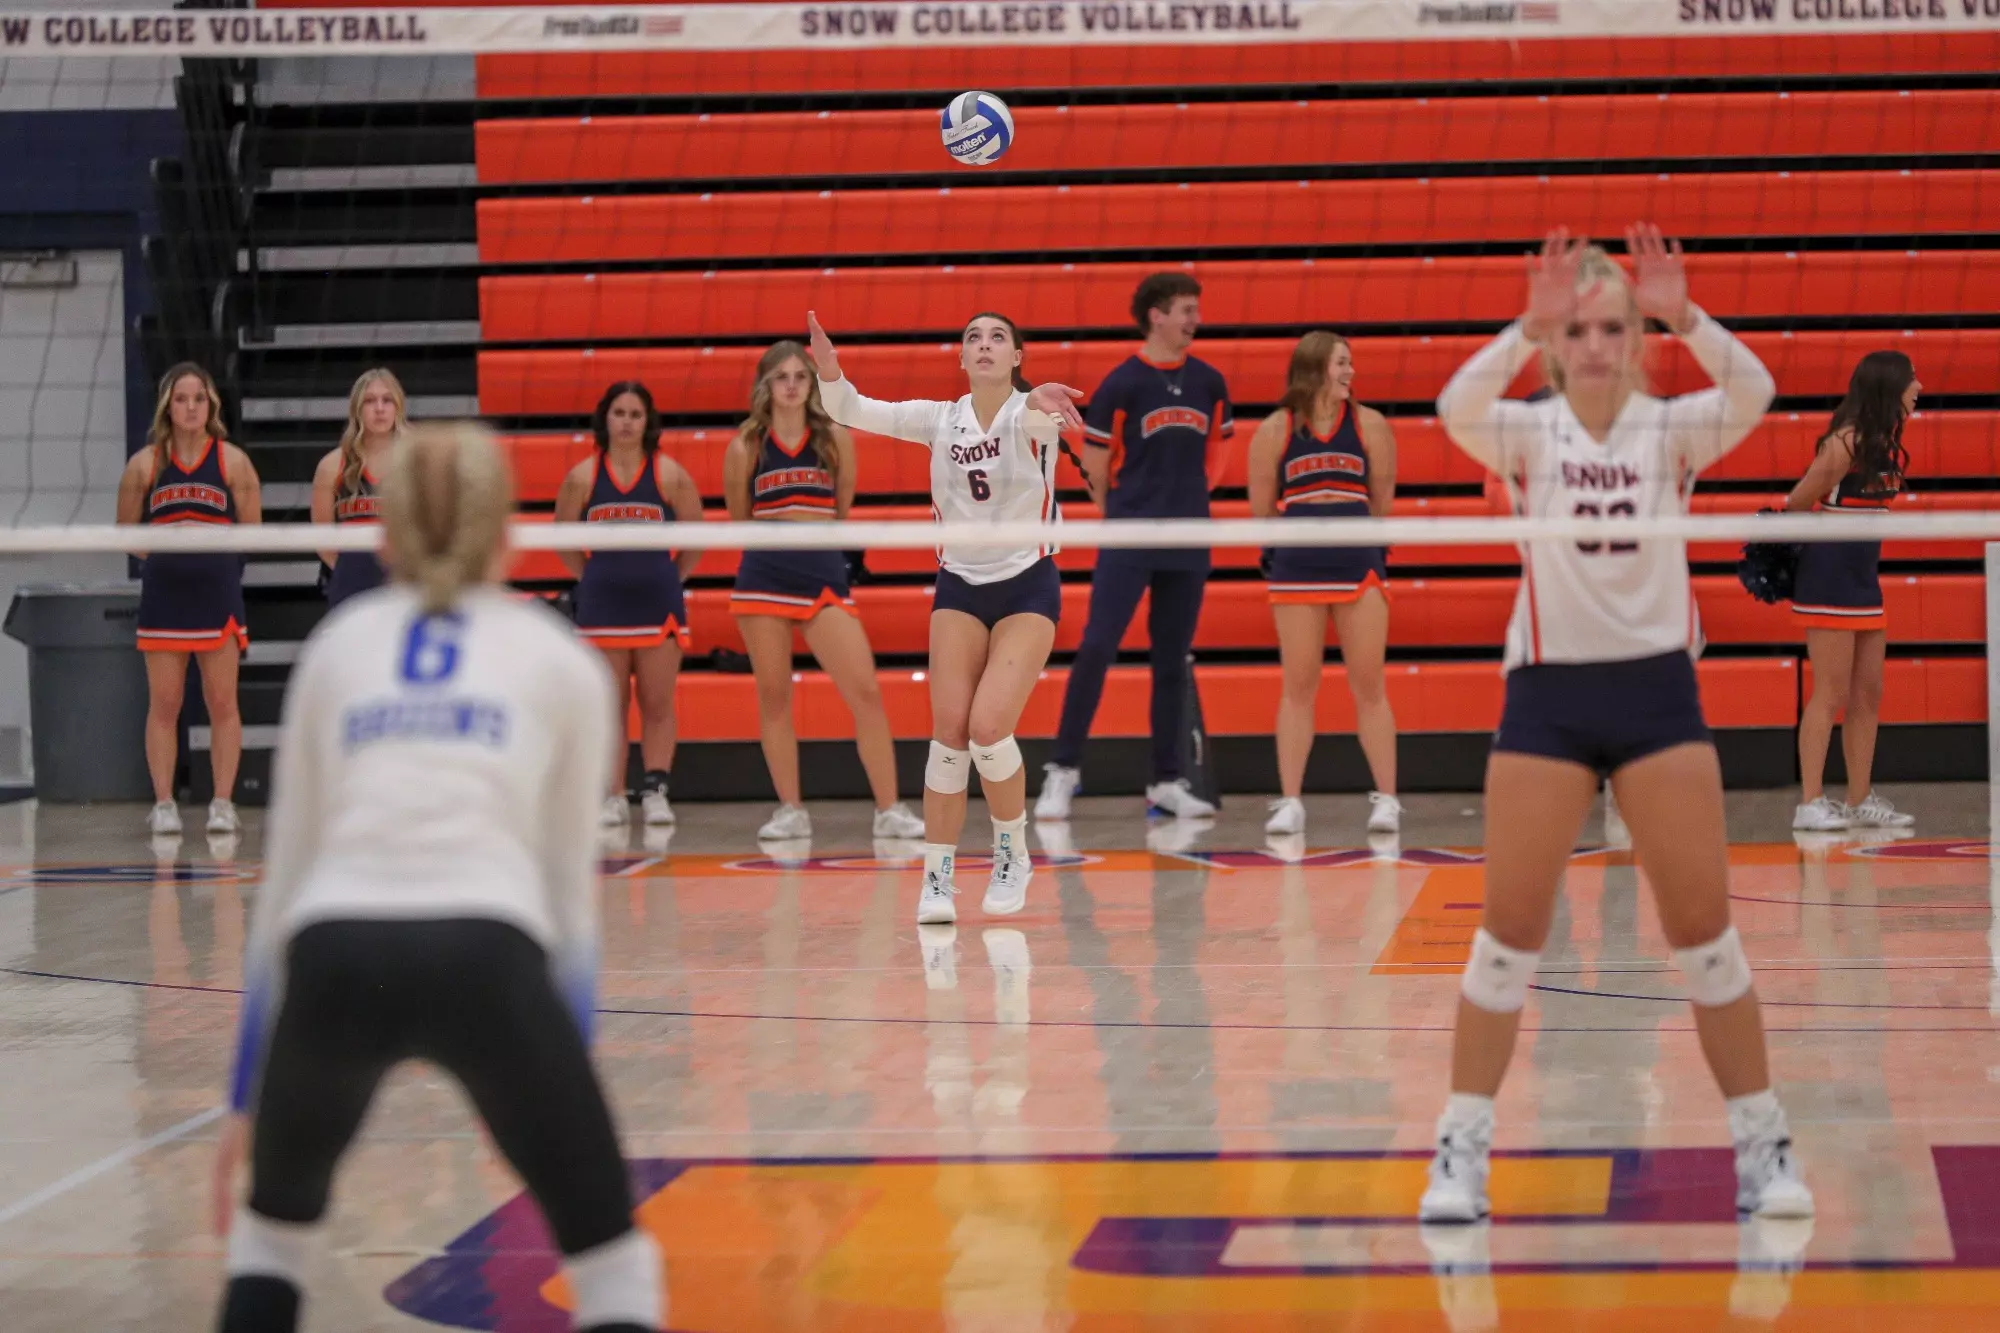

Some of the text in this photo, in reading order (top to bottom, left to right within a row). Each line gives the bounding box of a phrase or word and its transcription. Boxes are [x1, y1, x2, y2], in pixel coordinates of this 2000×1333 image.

[802, 3, 1300, 36] SNOW COLLEGE VOLLEYBALL
[1679, 0, 1777, 21] SNOW
[1792, 0, 1948, 20] COLLEGE
[44, 16, 196, 44] COLLEGE
[208, 15, 427, 44] VOLLEYBALL
[950, 131, 987, 154] molten
[949, 436, 1001, 465] SNOW
[967, 468, 992, 502] 6
[401, 612, 468, 686] 6
